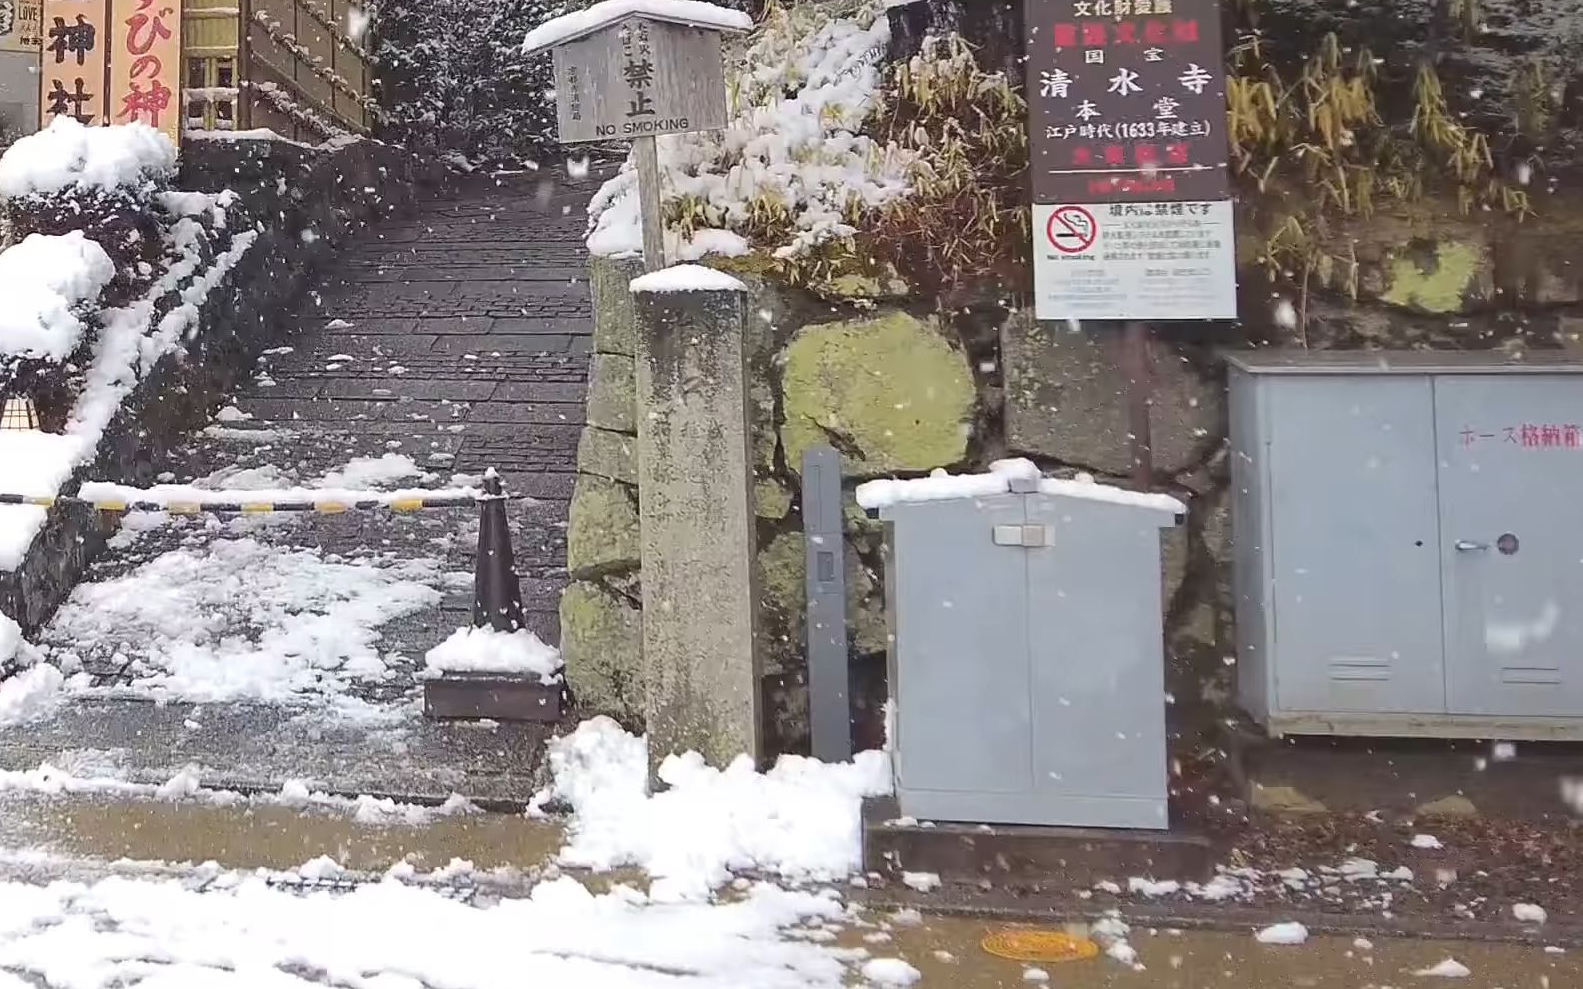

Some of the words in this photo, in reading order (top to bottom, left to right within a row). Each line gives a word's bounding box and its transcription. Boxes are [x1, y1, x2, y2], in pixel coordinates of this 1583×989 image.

[18, 3, 38, 21] LOVE
[1085, 47, 1164, 64] 国宝
[623, 59, 656, 117] 禁止
[1039, 63, 1213, 99] 清水寺
[1074, 96, 1181, 122] 本堂
[596, 123, 616, 136] NO
[623, 118, 689, 134] SMOKING
[1045, 120, 1211, 139] 江戸時代(1633年建立)
